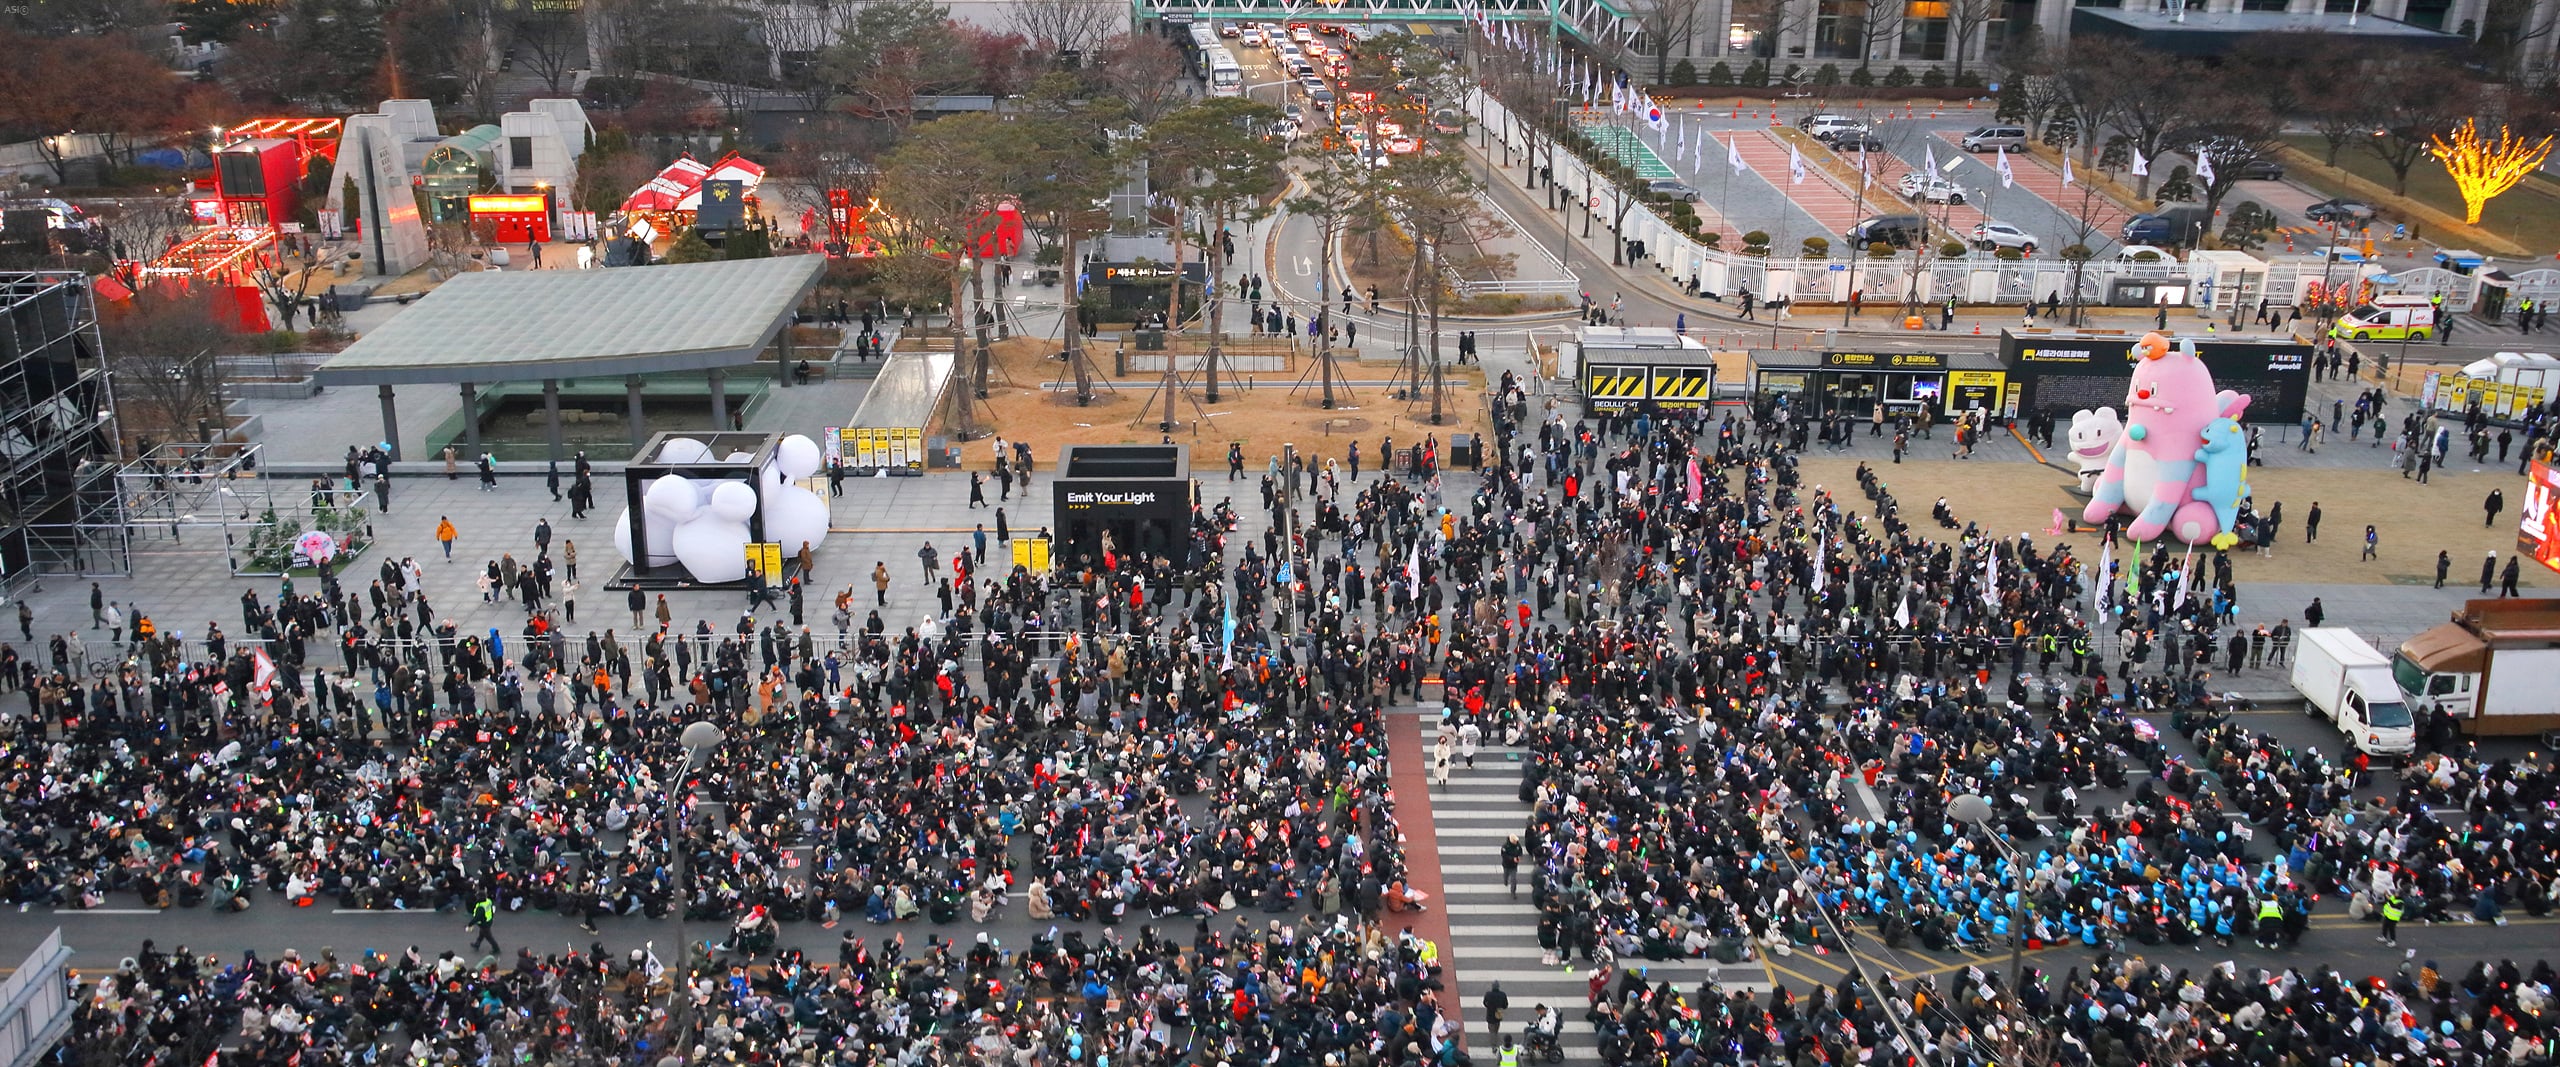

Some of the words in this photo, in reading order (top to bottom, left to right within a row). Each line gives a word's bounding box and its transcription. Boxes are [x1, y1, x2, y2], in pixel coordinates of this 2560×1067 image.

[1107, 268, 1116, 279] P
[1067, 492, 1094, 503] Emit
[1095, 492, 1123, 503] Your
[1124, 492, 1155, 505] Light
